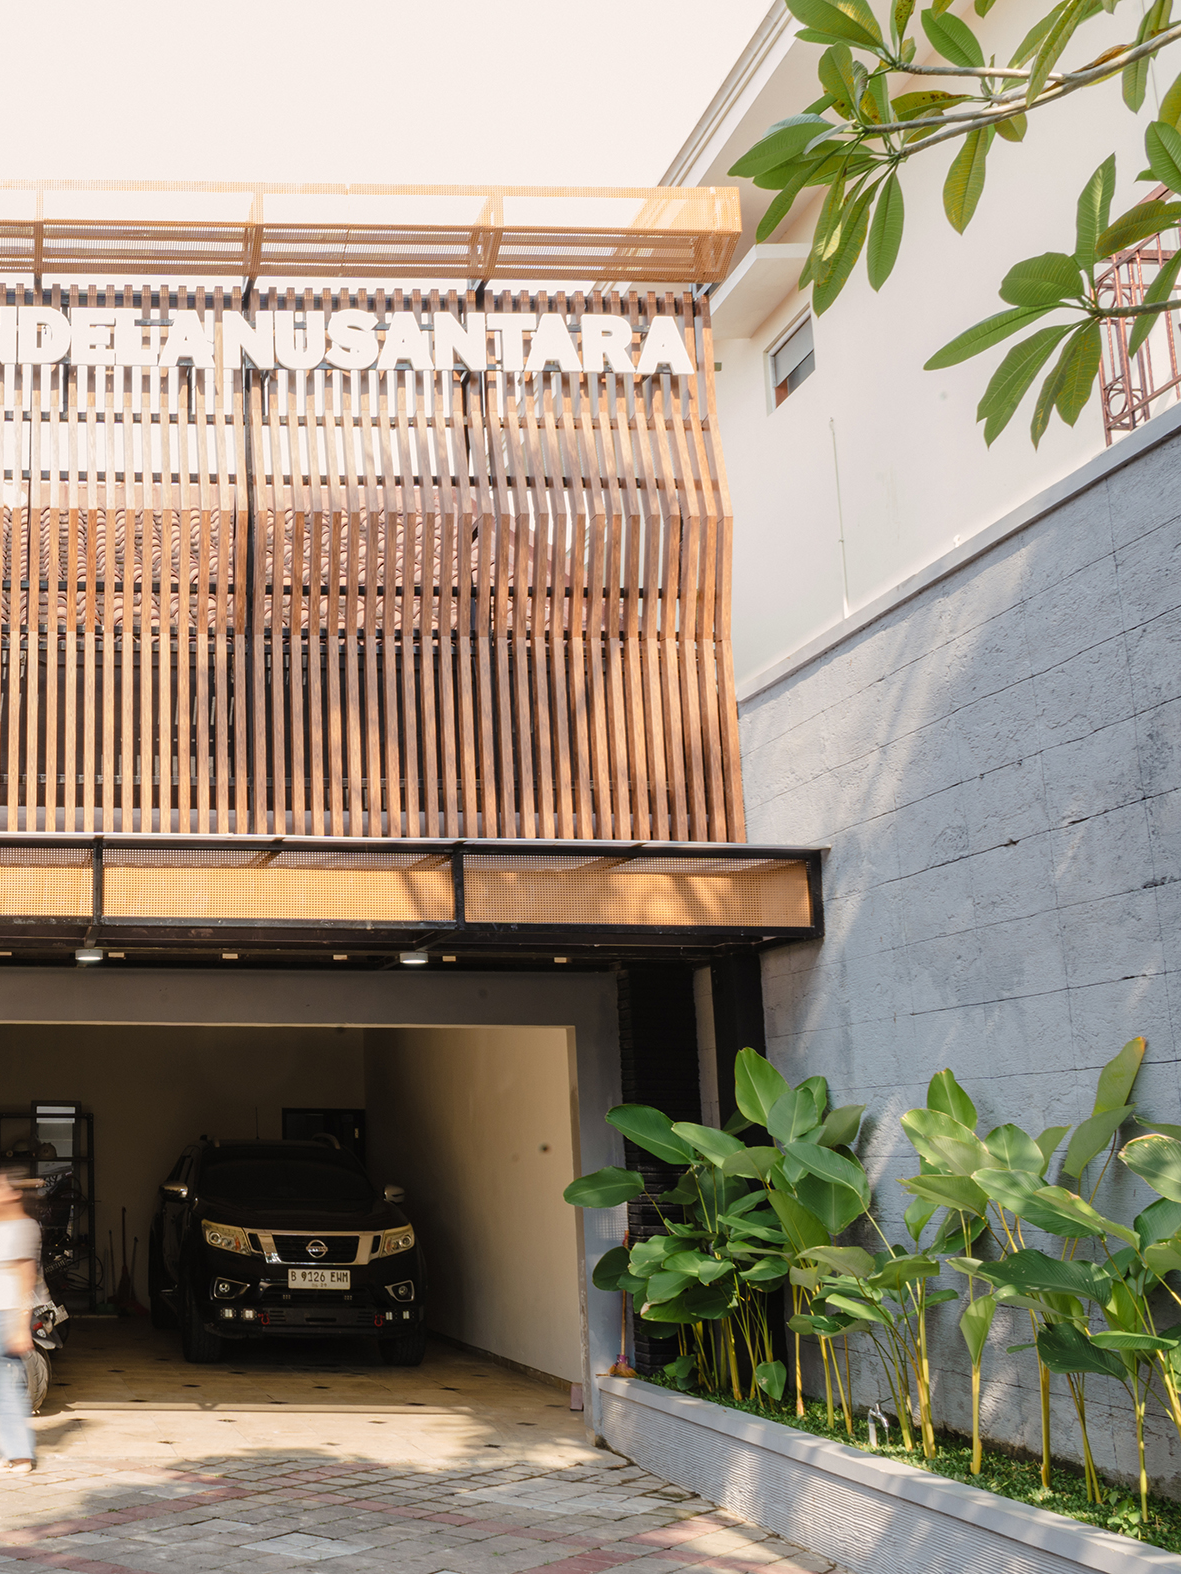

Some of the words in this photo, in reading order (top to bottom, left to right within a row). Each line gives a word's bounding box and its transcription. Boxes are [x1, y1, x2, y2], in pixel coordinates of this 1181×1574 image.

[221, 308, 695, 375] NUSANTARA
[290, 1271, 297, 1282] B
[301, 1271, 325, 1282] 9126
